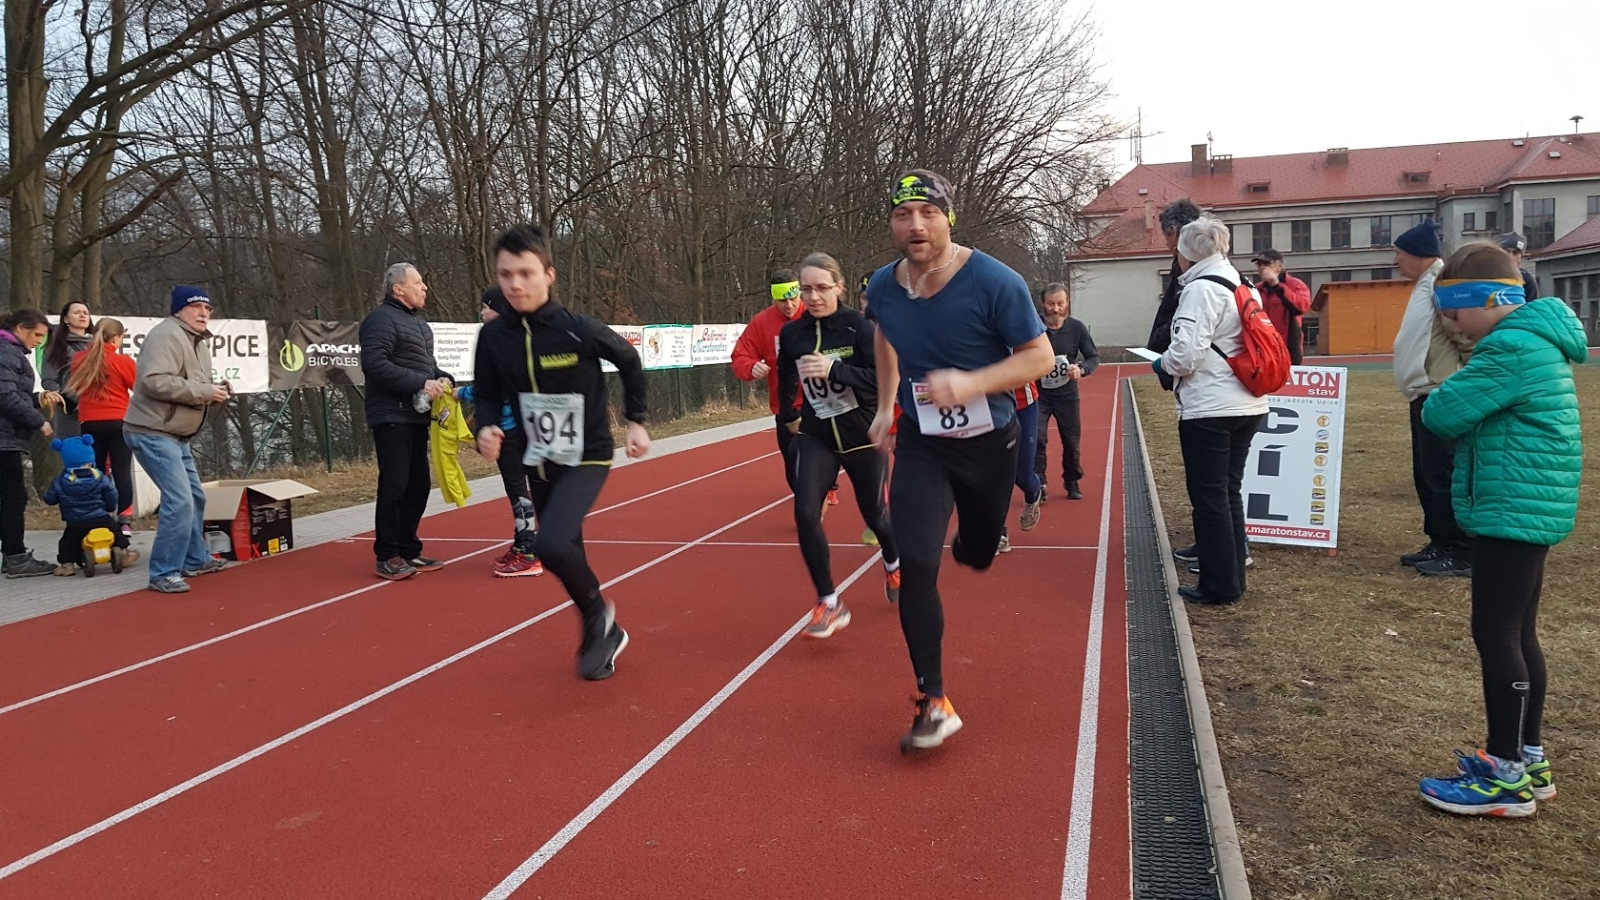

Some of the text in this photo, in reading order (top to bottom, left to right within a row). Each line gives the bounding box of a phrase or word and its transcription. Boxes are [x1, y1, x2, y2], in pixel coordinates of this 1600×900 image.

[187, 295, 210, 303] adidas
[211, 335, 259, 357] PICE
[305, 343, 361, 354] APACH
[308, 356, 359, 367] BICYCLES
[211, 367, 241, 380] e.cz
[1045, 363, 1067, 378] 88
[1307, 387, 1336, 396] stav
[939, 404, 969, 429] 83
[526, 411, 577, 445] 194
